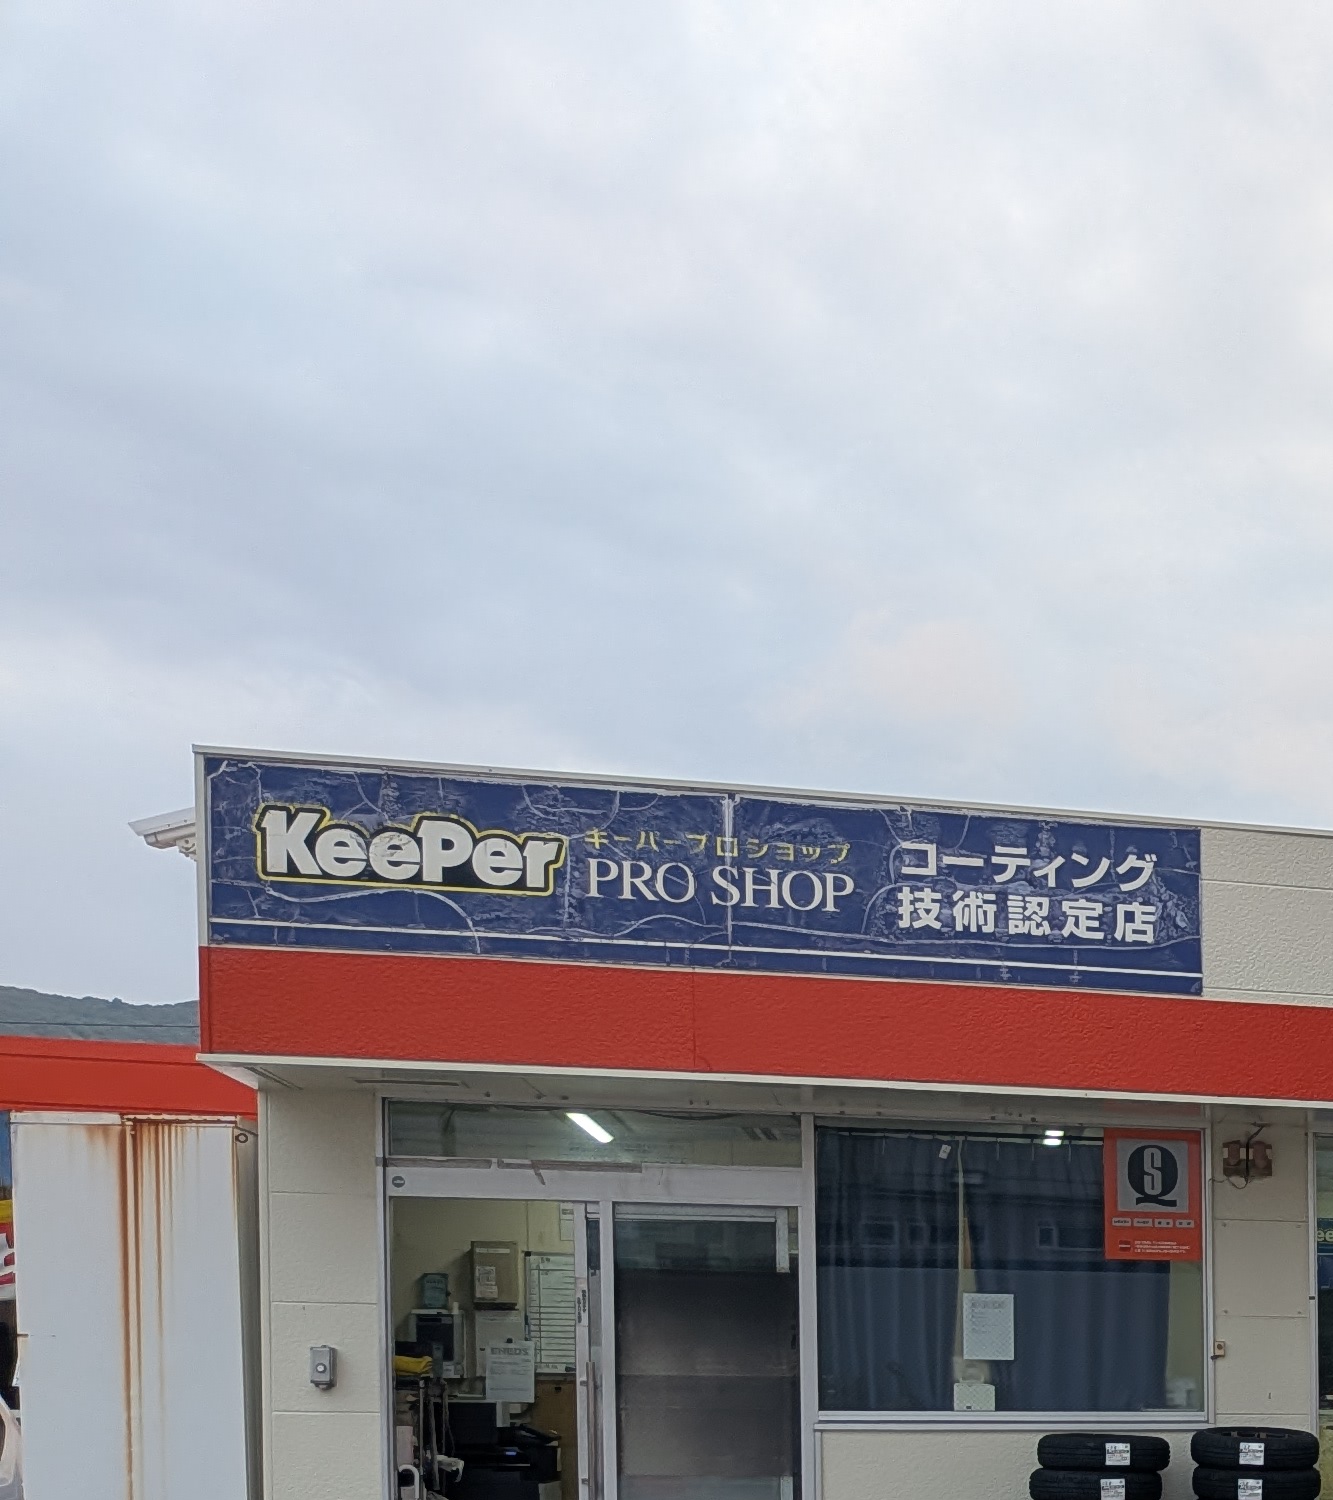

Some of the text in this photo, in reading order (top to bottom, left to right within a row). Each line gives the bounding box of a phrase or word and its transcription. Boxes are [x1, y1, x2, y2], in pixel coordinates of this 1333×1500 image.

[257, 805, 563, 893] KeePer
[583, 827, 852, 864] キーパープロショップ
[900, 841, 1155, 891] コーティング
[588, 858, 854, 913] PRO SHOP
[896, 887, 1156, 943] 技術認定店
